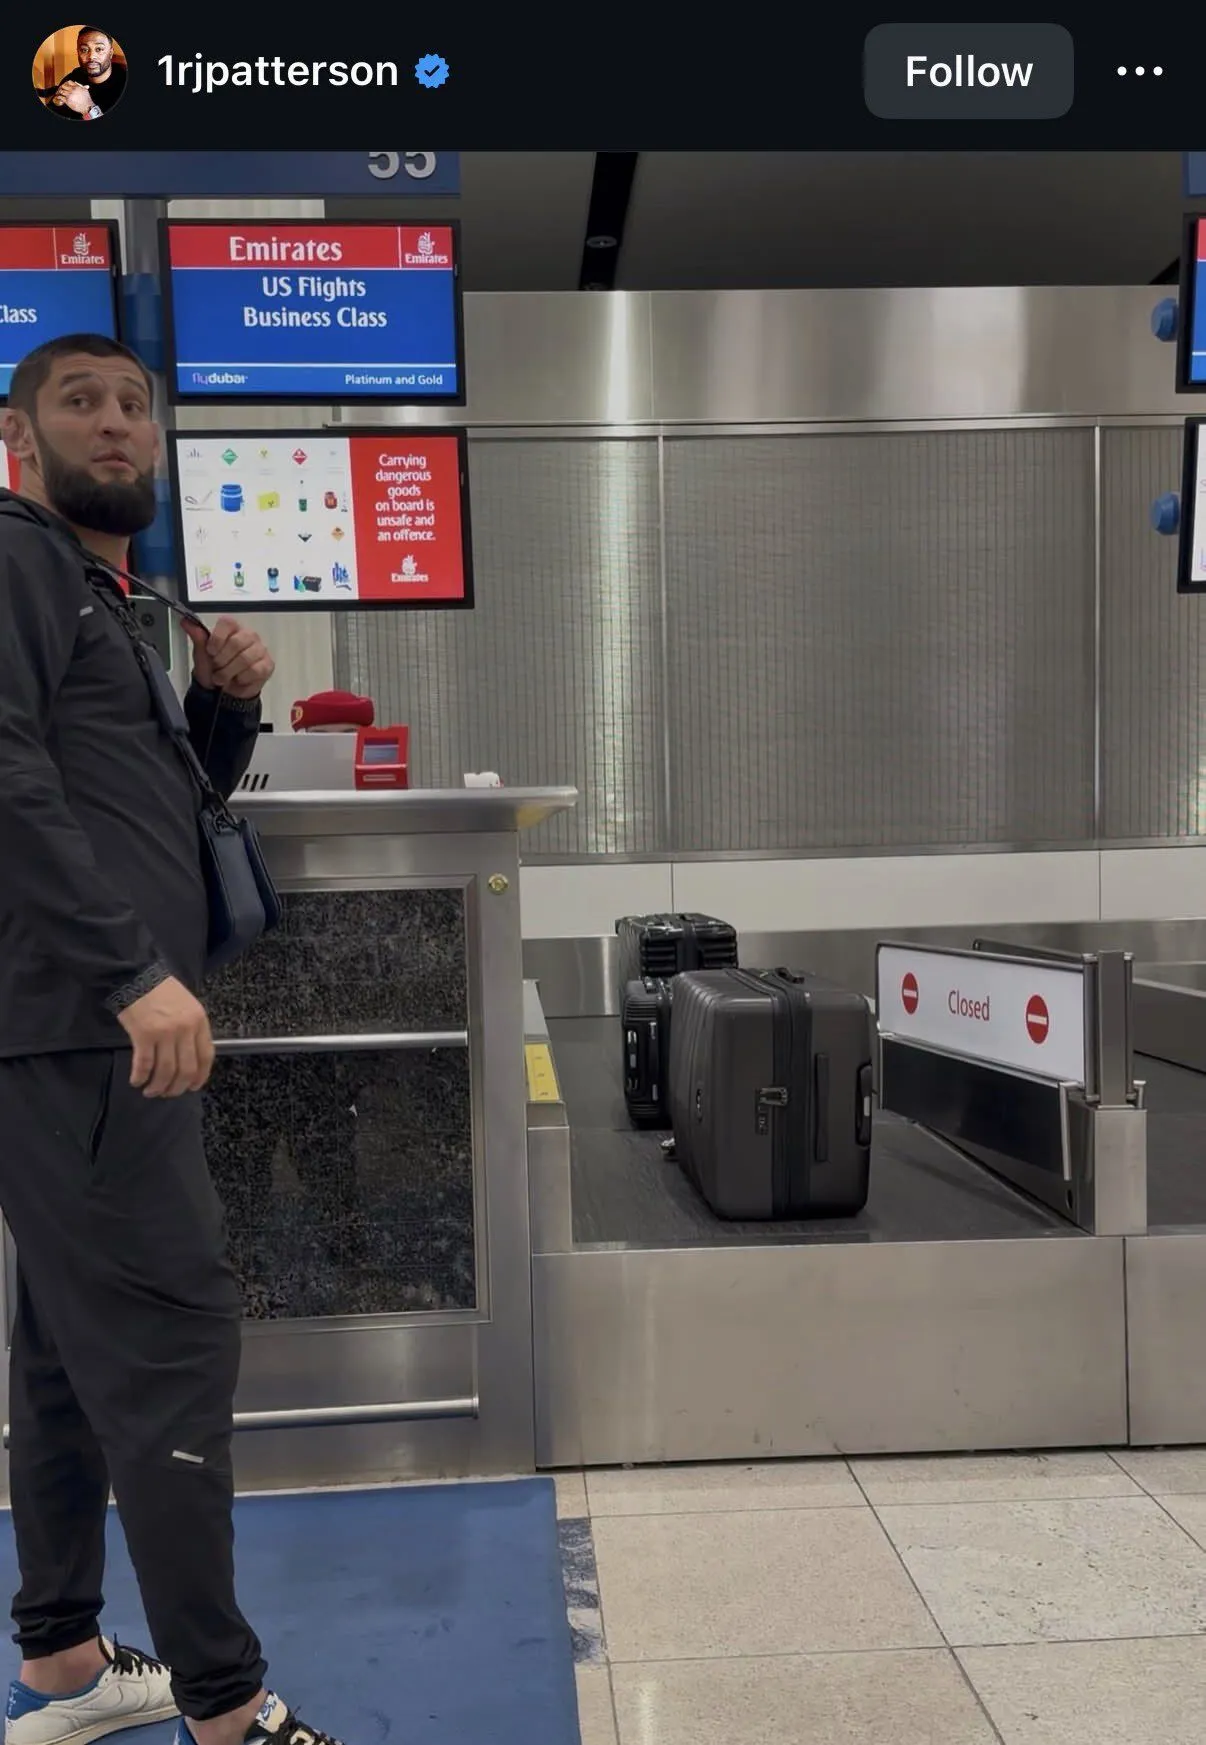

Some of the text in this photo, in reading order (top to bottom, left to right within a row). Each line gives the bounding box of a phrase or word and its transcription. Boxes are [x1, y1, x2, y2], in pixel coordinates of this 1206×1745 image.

[367, 151, 437, 178] 55
[229, 236, 343, 262] Emirates
[60, 254, 105, 265] Emirates
[405, 253, 449, 264] Emirates
[262, 276, 367, 302] US Flights
[0, 304, 38, 324] lass
[243, 306, 388, 328] Business Class
[345, 374, 443, 385] Platinum and Gold
[378, 453, 427, 469] Carrying
[375, 468, 432, 484] dangerous
[387, 484, 422, 499] goods
[375, 498, 435, 512] on board is
[376, 513, 435, 527] unsafe and
[377, 528, 436, 542] an offence.
[947, 989, 990, 1022] Closed
